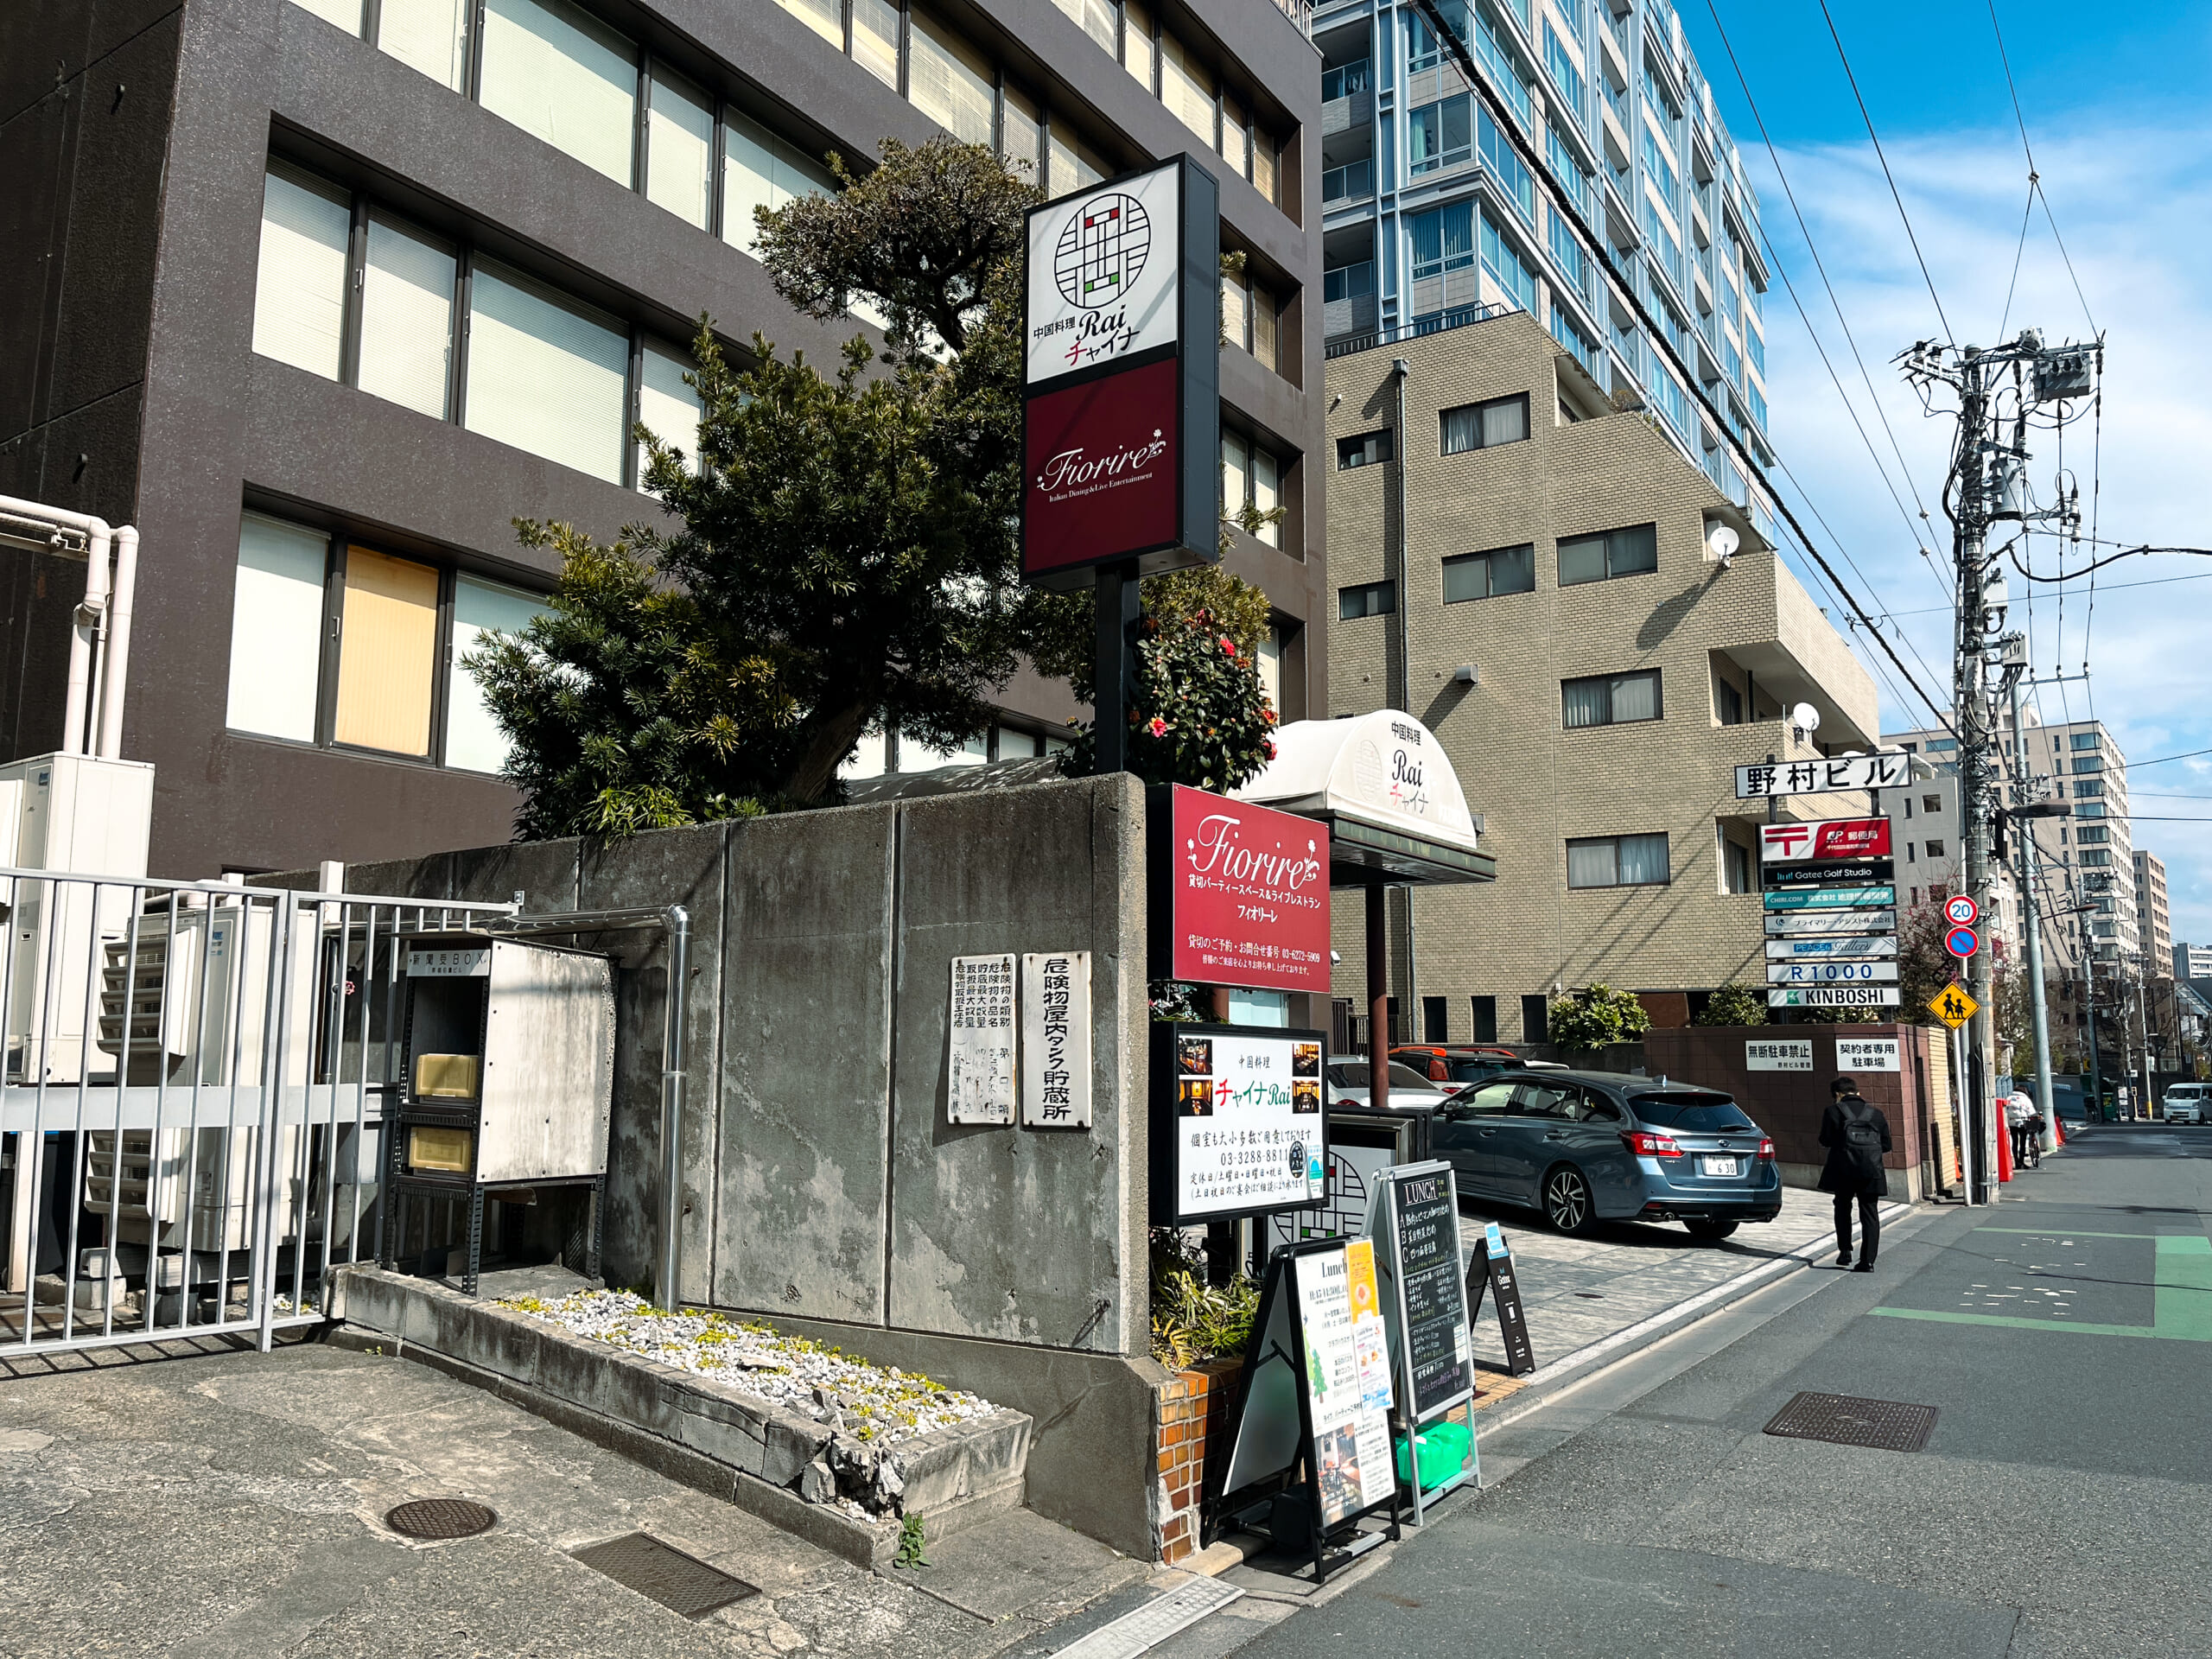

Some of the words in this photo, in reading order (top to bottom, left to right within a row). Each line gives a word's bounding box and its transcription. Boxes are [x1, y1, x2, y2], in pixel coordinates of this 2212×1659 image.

[1033, 316, 1076, 339] 中国料理
[1076, 304, 1126, 340] Rai
[1065, 326, 1141, 366] チャイナ
[1040, 442, 1151, 492] Fiorire
[1049, 493, 1068, 503] Italian
[1109, 472, 1153, 488] Entertainment
[1391, 721, 1421, 746] 中国料理
[1392, 749, 1422, 787] Rai
[1747, 759, 1896, 795] 野村ビル
[1389, 782, 1428, 814] チャイナ
[1191, 814, 1309, 890] Fiorire
[1823, 869, 1843, 878] Golf
[1844, 868, 1872, 877] Studio
[1237, 905, 1278, 923] フィオリーレ
[1952, 904, 1970, 918] 20
[976, 963, 988, 1028] 貯蔵最大数量
[988, 963, 1001, 1027] 危険物の品名
[1806, 988, 1885, 1005] KINBOSHI
[1042, 958, 1071, 1122] 危険物屋内タンク貯蔵所
[1748, 1045, 1810, 1058] 無断駐車禁止
[1840, 1044, 1895, 1054] 契約者専用
[1238, 1054, 1270, 1070] 中国料理
[1852, 1057, 1885, 1067] 駐車場
[1220, 1148, 1288, 1166] 03-3288-8811
[1404, 1179, 1436, 1205] LUNCH
[1401, 1230, 1407, 1244] B
[1402, 1247, 1408, 1263] C
